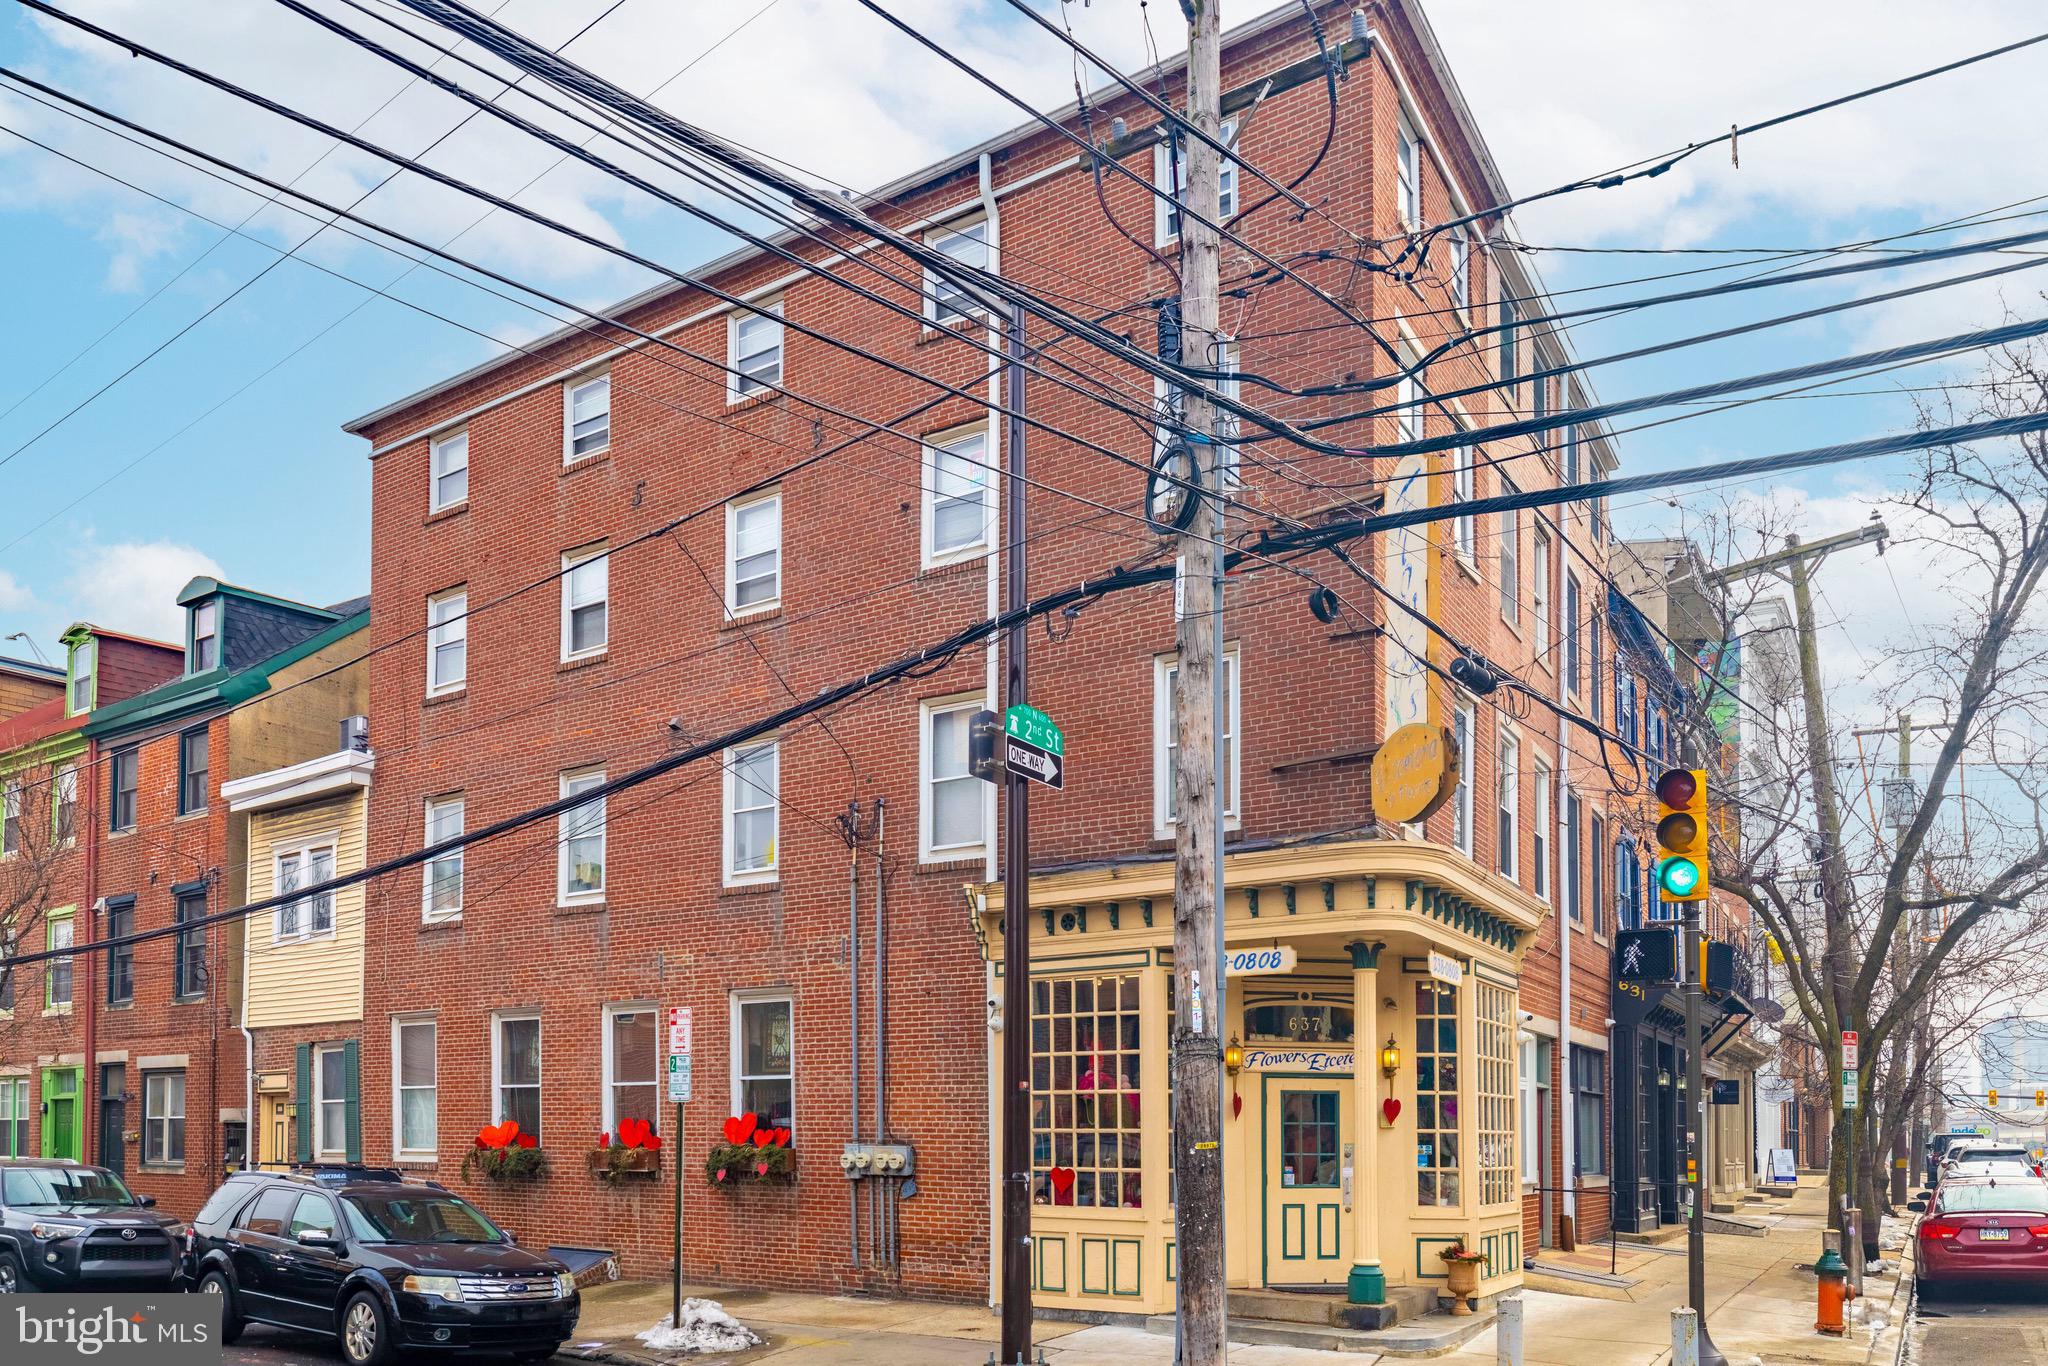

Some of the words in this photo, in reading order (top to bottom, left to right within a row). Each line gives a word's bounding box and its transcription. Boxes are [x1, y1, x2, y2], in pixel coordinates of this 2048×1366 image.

[1032, 709, 1038, 721] N
[1025, 719, 1042, 741] 2nd
[1045, 728, 1060, 752] St
[1010, 746, 1027, 766] ONE
[1028, 754, 1045, 772] WAY
[1618, 980, 1645, 1001] 631
[1289, 1017, 1321, 1031] 637
[676, 1035, 686, 1043] TIME
[671, 1058, 676, 1071] 2
[1244, 1051, 1308, 1069] Flowers
